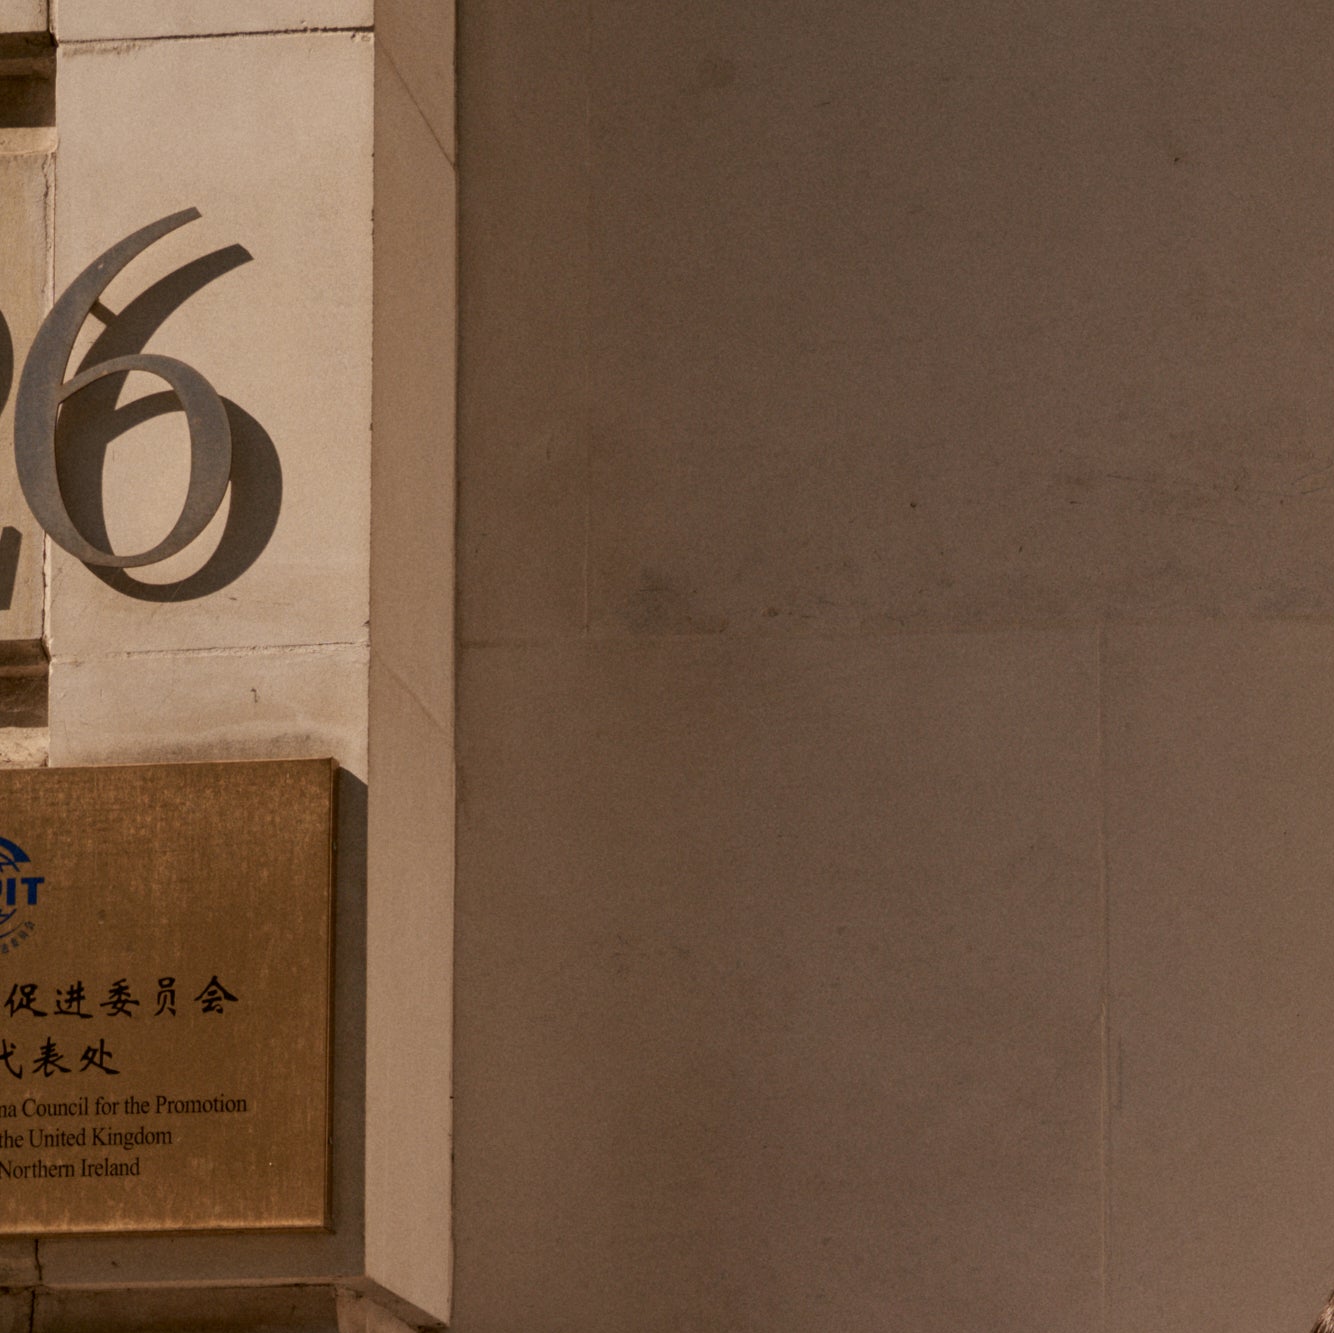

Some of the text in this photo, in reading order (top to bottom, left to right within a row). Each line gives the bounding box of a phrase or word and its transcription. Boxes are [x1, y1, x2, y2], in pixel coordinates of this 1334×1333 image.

[0, 877, 45, 906] IT
[4, 975, 239, 1018] 促进委员会
[22, 1097, 88, 1117] Council
[95, 1096, 119, 1115] for
[124, 1096, 150, 1114] the
[156, 1093, 247, 1114] Promotion
[0, 1126, 172, 1150] the United Kingdom
[0, 1157, 140, 1179] Northern Ireland
